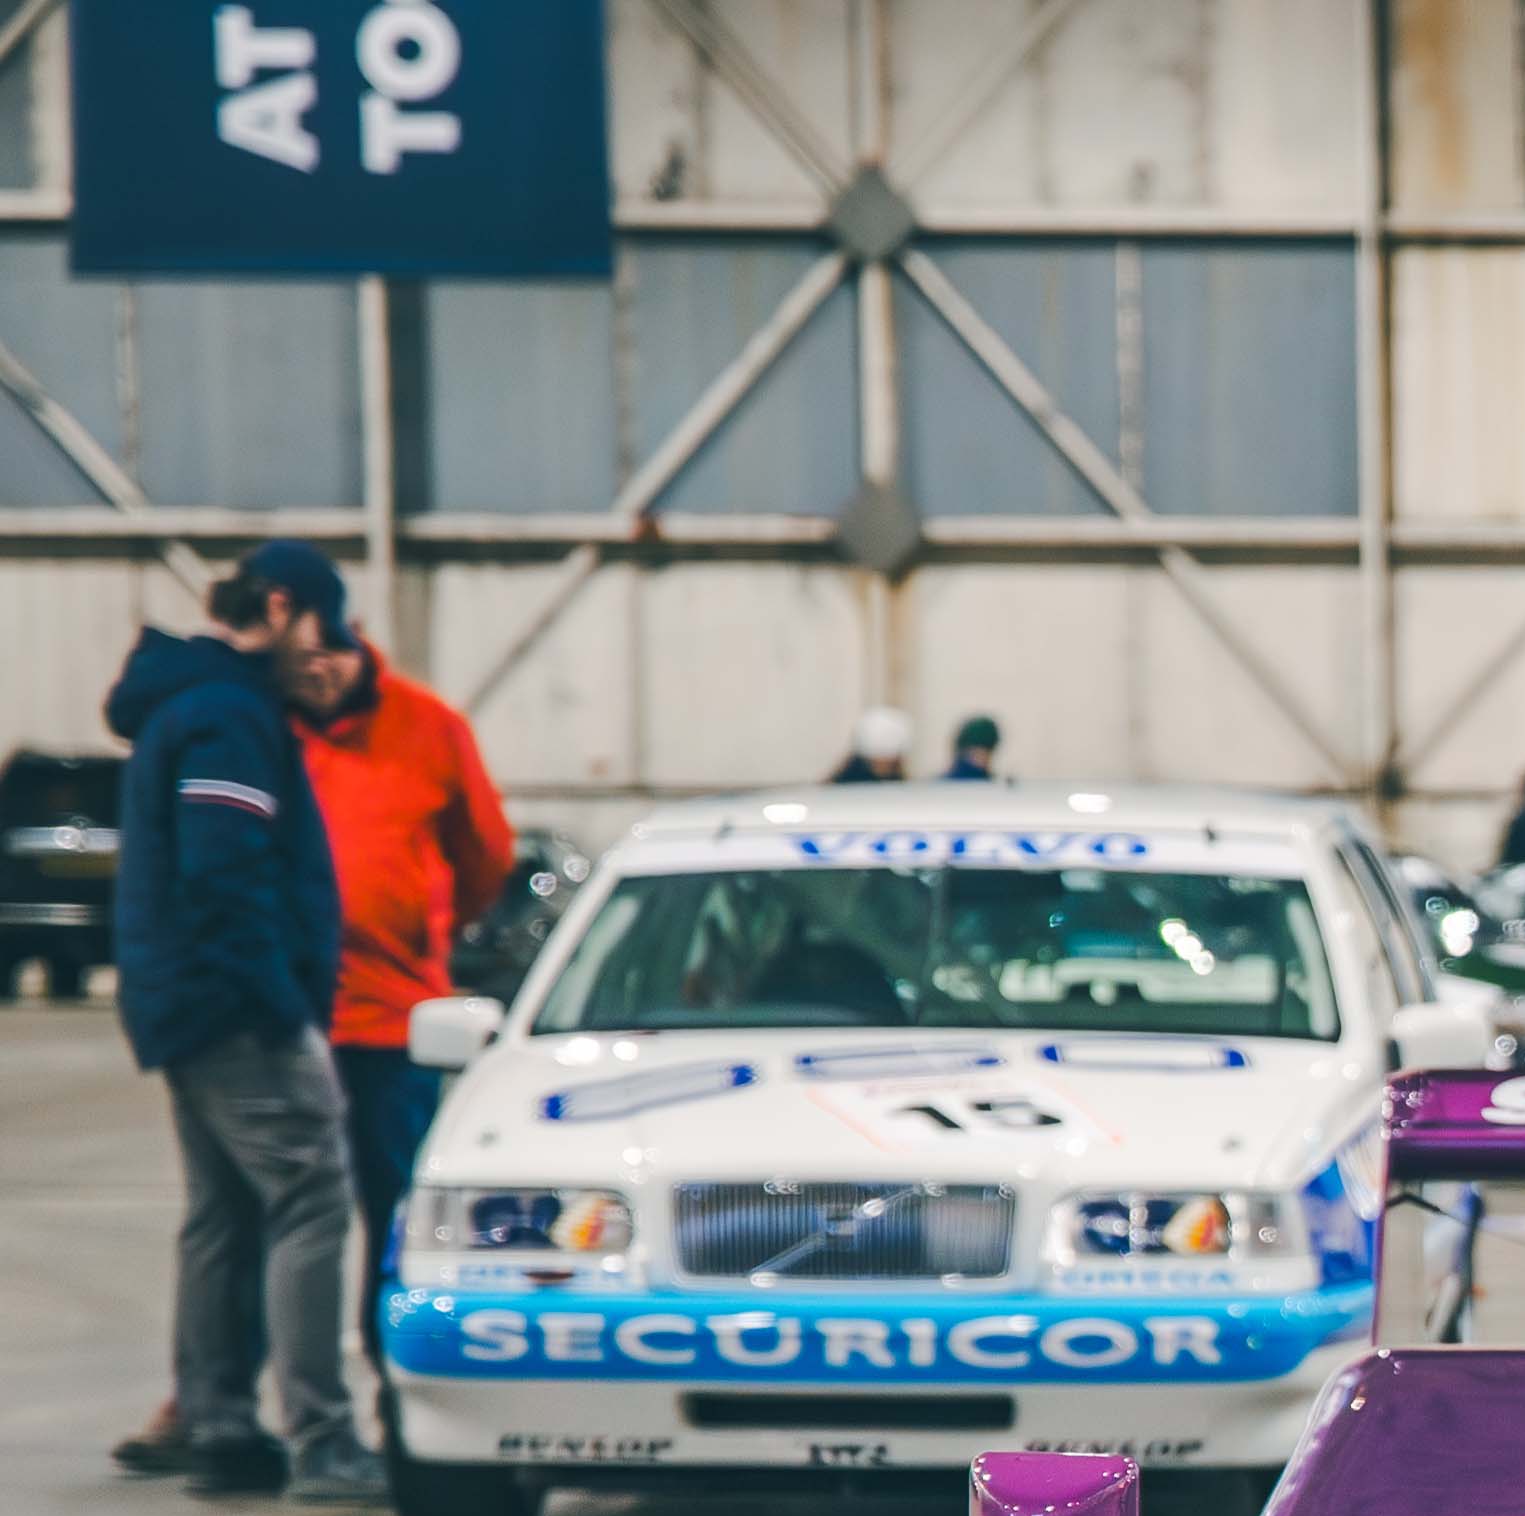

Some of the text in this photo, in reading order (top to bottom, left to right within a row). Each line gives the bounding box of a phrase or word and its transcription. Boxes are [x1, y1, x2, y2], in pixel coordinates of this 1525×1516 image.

[213, 4, 320, 174] AT
[785, 830, 1150, 868] VOLVO
[460, 1308, 1222, 1367] SECURICOR
